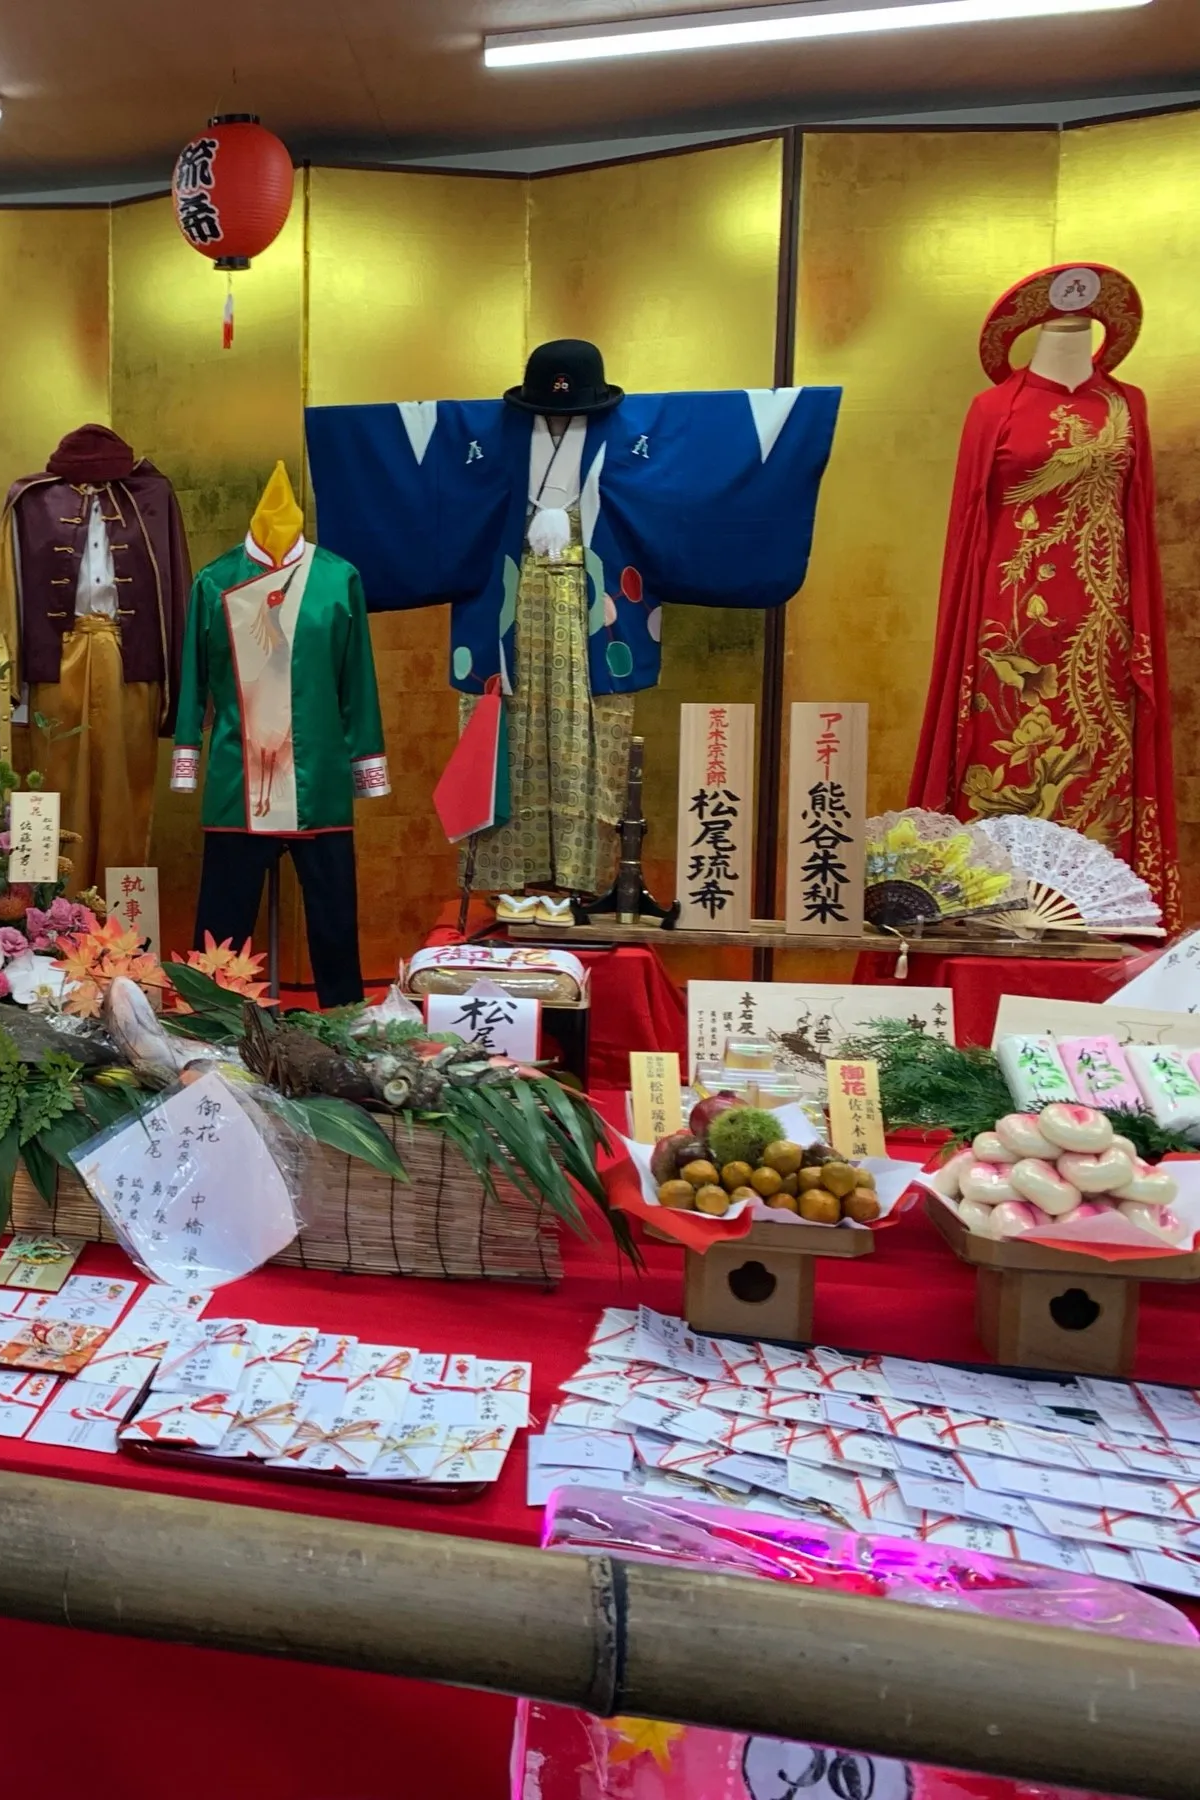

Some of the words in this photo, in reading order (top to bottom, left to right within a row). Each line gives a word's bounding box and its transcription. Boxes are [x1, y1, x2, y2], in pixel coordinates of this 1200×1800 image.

[706, 708, 729, 788] 荒木宗太郎
[816, 712, 843, 781] アニオー
[687, 788, 741, 919] 松尾琉希
[800, 781, 854, 924] 熊谷朱梨
[451, 997, 518, 1056] 松尾
[839, 1064, 867, 1097] 御花
[145, 1116, 167, 1160] 松尾
[196, 1095, 222, 1143] 御花
